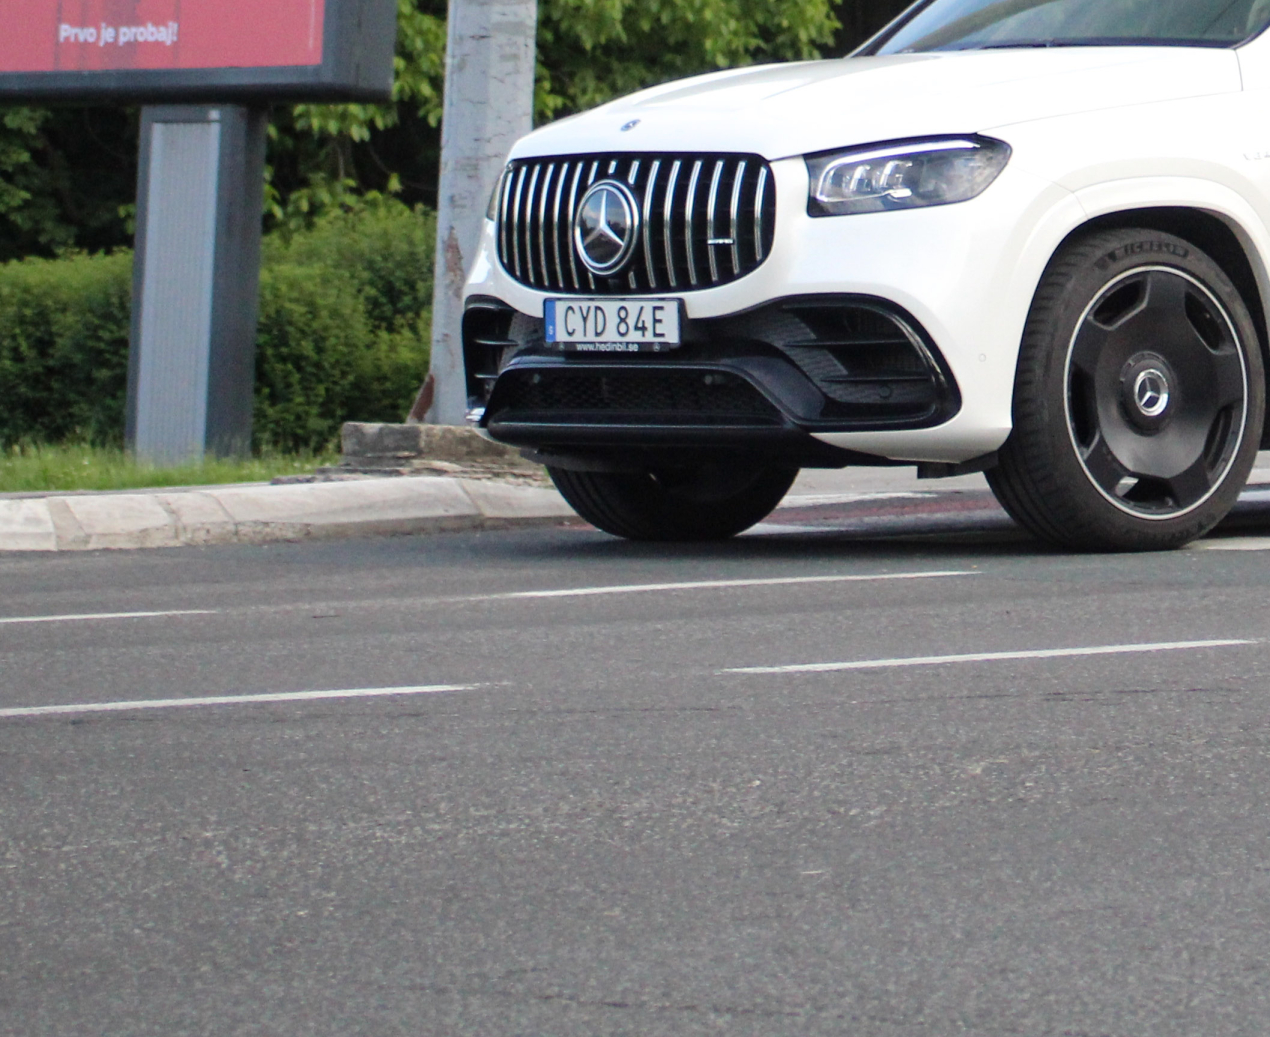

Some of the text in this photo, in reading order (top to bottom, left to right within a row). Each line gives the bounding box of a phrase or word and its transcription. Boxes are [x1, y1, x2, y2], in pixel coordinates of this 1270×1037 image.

[59, 22, 179, 46] Prvo je probaj!
[564, 305, 666, 337] CYD 84E
[576, 342, 639, 352] www.hedinbil.se
